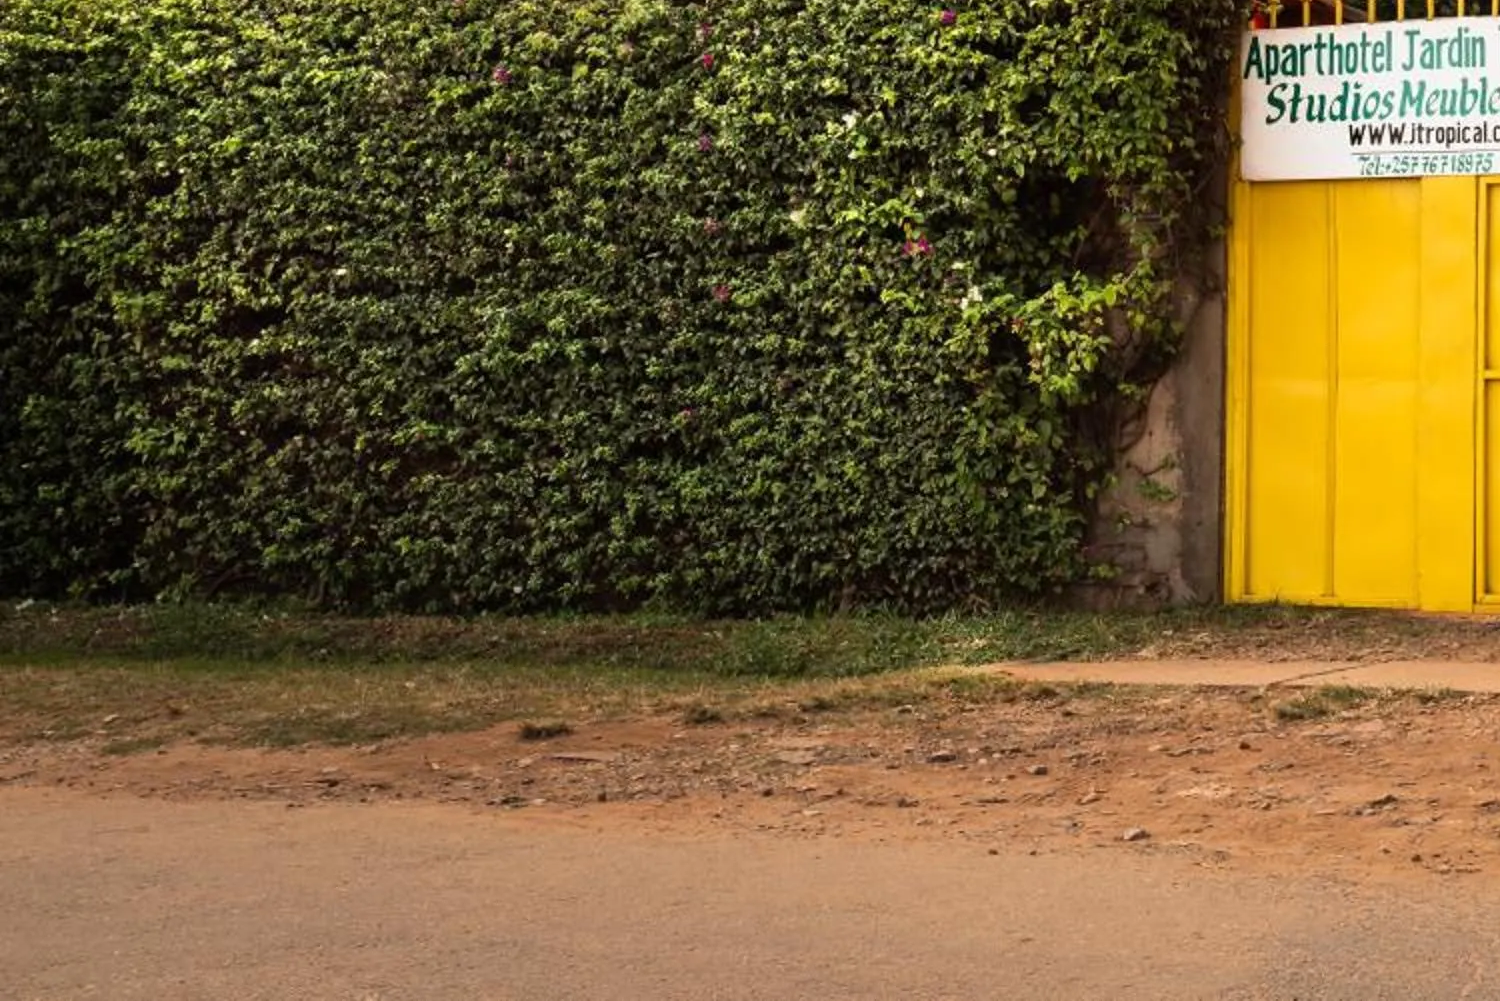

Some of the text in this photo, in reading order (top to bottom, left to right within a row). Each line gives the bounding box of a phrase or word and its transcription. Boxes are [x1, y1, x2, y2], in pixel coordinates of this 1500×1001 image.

[1243, 30, 1393, 85] Aparthotel
[1401, 26, 1487, 72] Jardin
[1265, 80, 1396, 125] Studios
